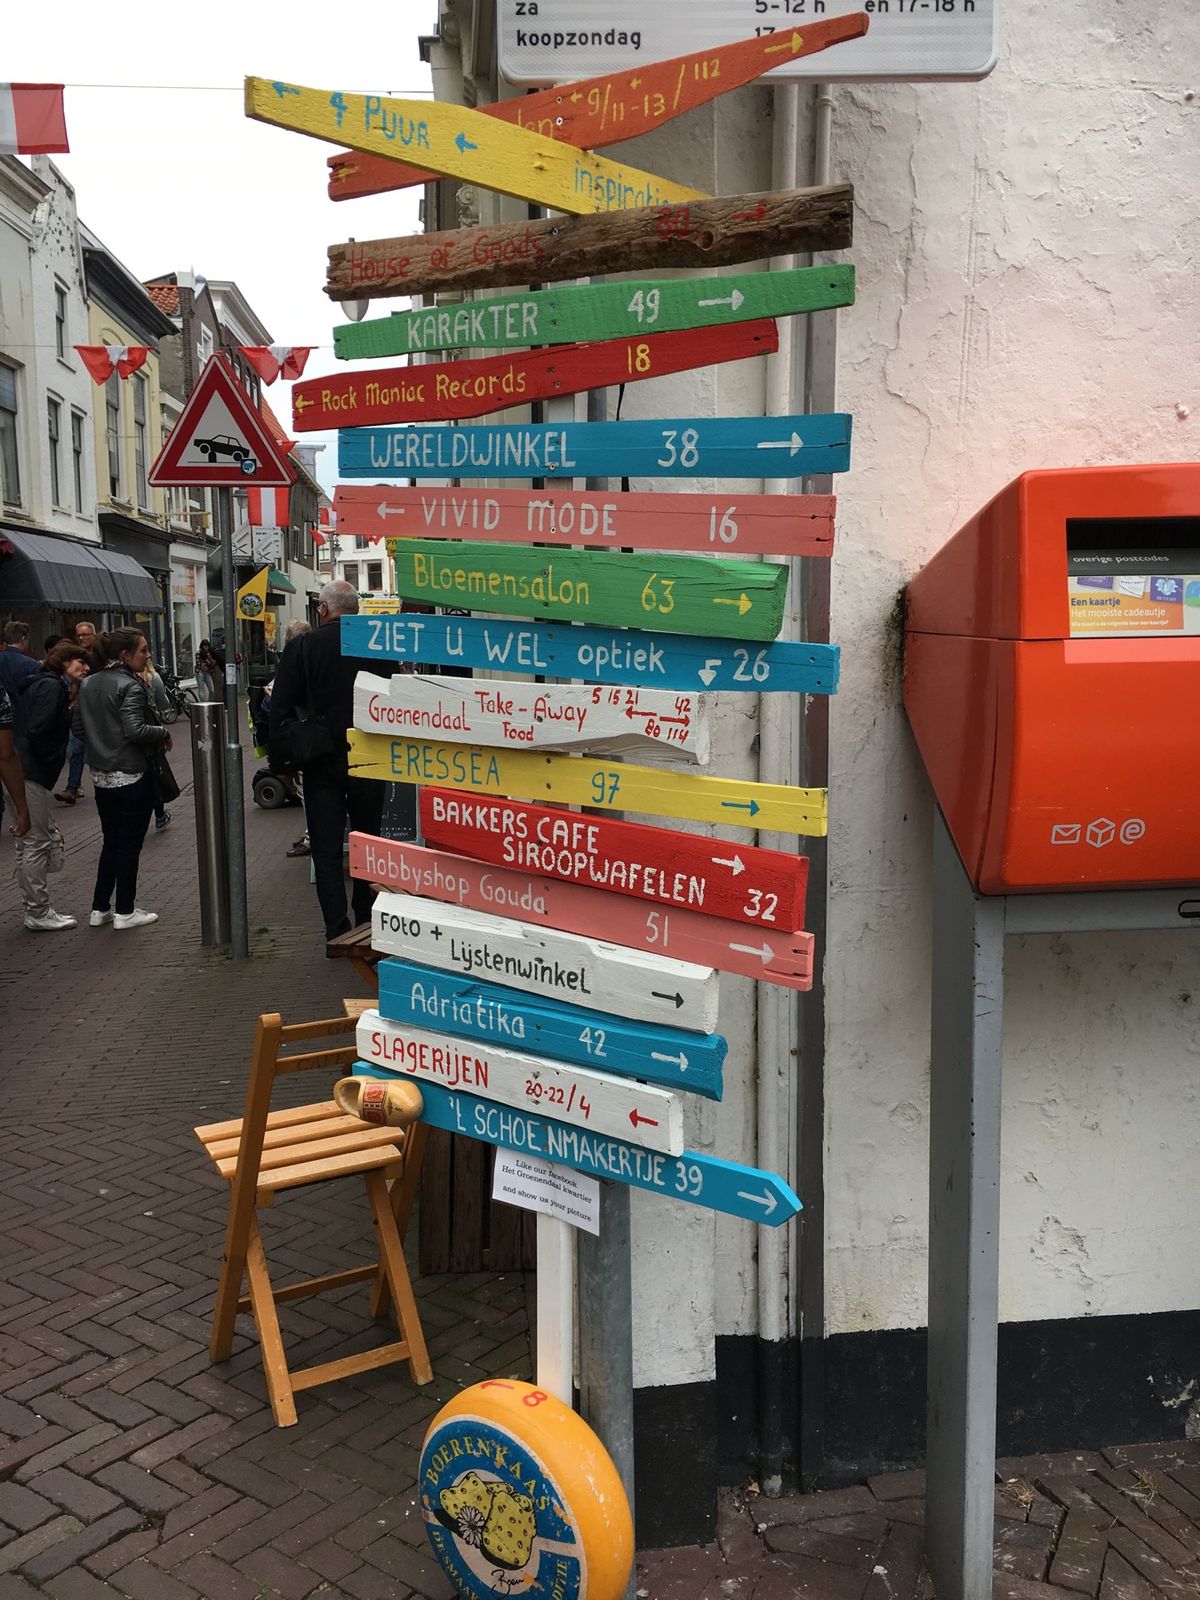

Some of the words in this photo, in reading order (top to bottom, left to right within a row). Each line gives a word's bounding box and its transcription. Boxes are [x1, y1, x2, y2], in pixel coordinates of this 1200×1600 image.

[515, 1, 539, 16] za
[865, 0, 888, 13] en
[516, 29, 642, 49] koopzondag
[351, 247, 411, 283] House
[473, 226, 545, 265] Goods
[407, 302, 538, 349] KARAKTER
[628, 288, 661, 323] 49
[322, 386, 357, 412] Rock
[365, 380, 425, 406] Maniac
[436, 364, 526, 401] Records
[627, 343, 651, 374] 18
[370, 431, 576, 468] WERELDWINKEL
[657, 428, 699, 468] 38
[421, 496, 500, 530] VIVID
[709, 506, 738, 543] 16
[1073, 555, 1113, 564] overige
[1116, 555, 1169, 563] postcodes
[414, 553, 590, 606] Bloemensalon
[641, 573, 675, 613] 63
[1071, 598, 1087, 606] Een
[1089, 597, 1121, 608] kaartje
[1071, 609, 1086, 618] Het
[1088, 609, 1122, 618] mooiste
[1124, 608, 1166, 618] cadeautje
[368, 620, 425, 653] ZIET
[484, 630, 547, 667] WEL
[577, 639, 666, 677] optiek
[733, 648, 770, 682] 26
[368, 694, 471, 731] Groenendaal
[592, 687, 602, 704] 5
[608, 688, 621, 705] 15
[625, 689, 639, 706] 21
[675, 696, 691, 715] 42
[503, 721, 534, 741] Food
[667, 727, 689, 746] 114
[390, 741, 500, 786] ERESSEA
[592, 771, 620, 804] 97
[433, 797, 527, 838] BAKKERS
[537, 817, 600, 854] CAFE
[366, 845, 470, 902] Hobbyshop
[480, 873, 546, 914] Gouda
[645, 911, 669, 947] 51
[503, 836, 705, 906] SIROOPWAFELEN
[743, 889, 778, 922] 32
[411, 982, 525, 1039] Adriatika
[579, 1026, 607, 1057] 42
[502, 1165, 515, 1175] Het
[516, 1170, 561, 1191] Groenendaal
[563, 1185, 592, 1204] kwartier
[515, 1160, 532, 1171] Like
[534, 1166, 547, 1175] our
[548, 1170, 578, 1188] facebook
[675, 1162, 703, 1196] 39
[502, 1185, 516, 1195] and
[518, 1189, 538, 1200] show
[539, 1196, 549, 1204] us
[550, 1200, 566, 1211] your
[567, 1206, 592, 1222] picture
